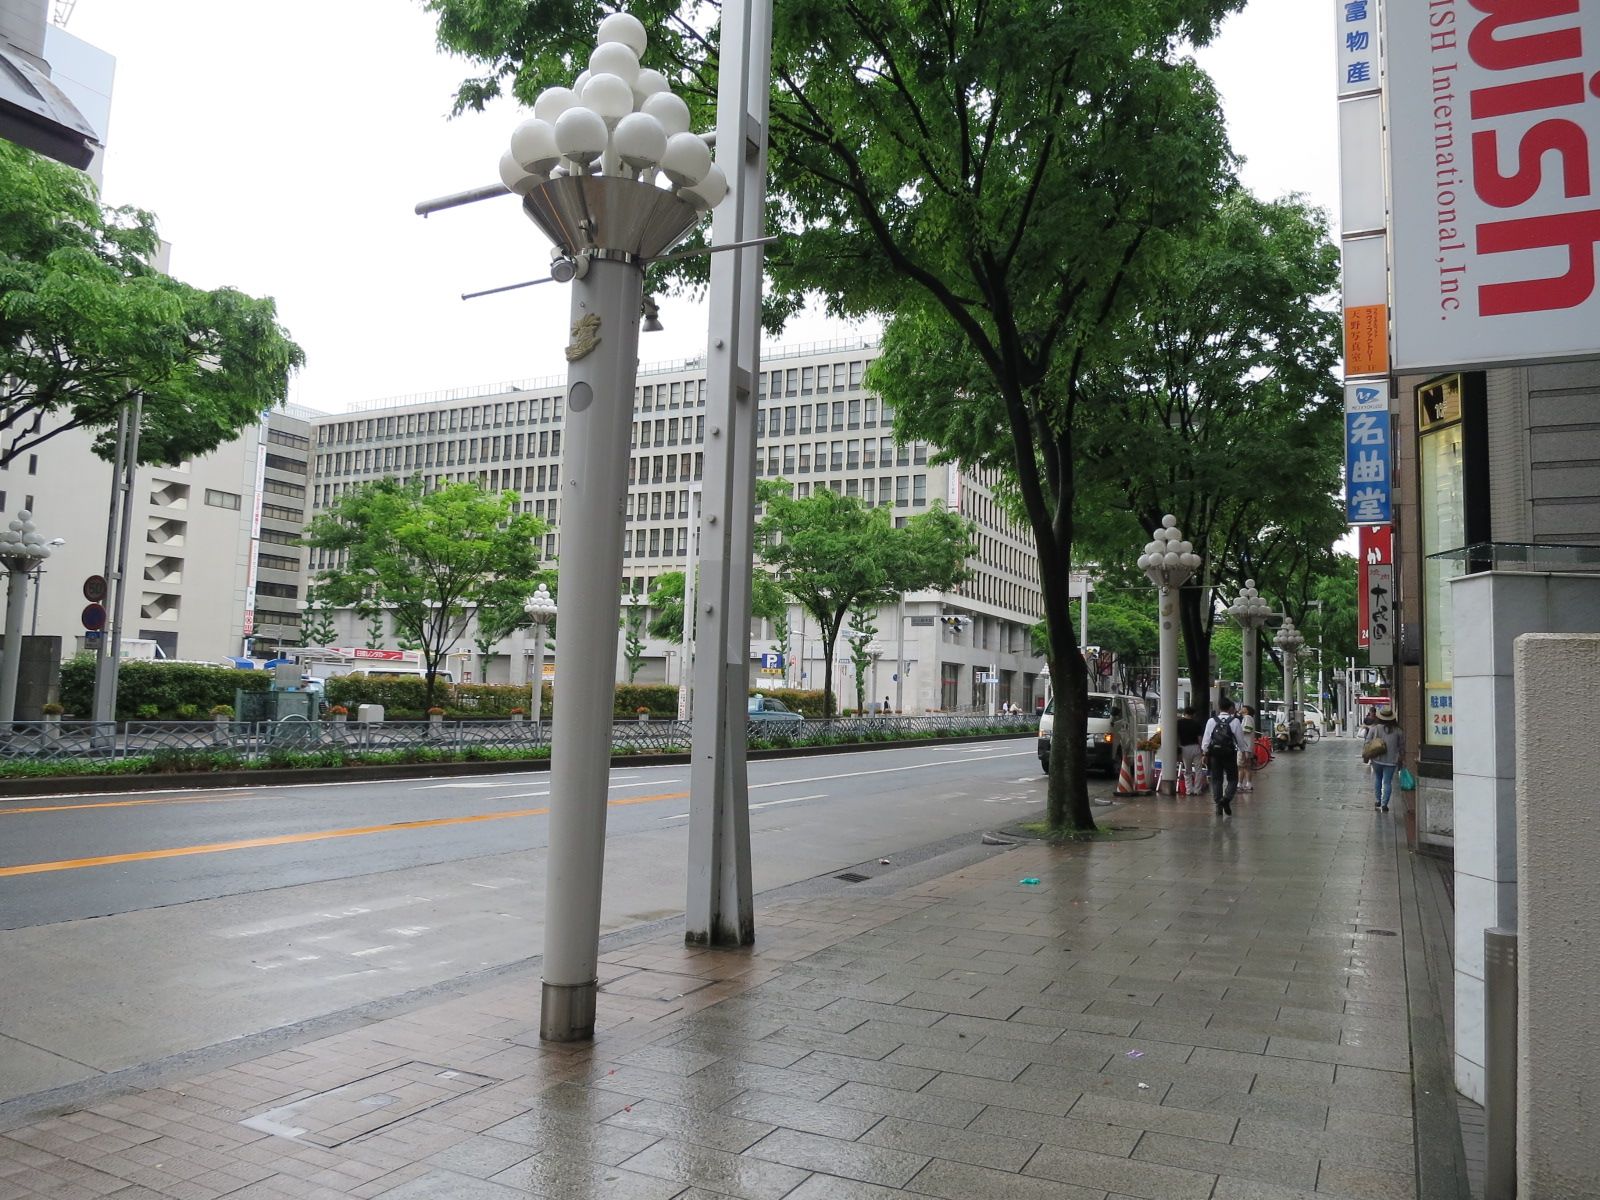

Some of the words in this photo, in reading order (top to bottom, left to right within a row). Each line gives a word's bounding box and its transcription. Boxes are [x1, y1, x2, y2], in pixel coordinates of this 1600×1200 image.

[1431, 62, 1467, 321] International,Inc.
[1350, 413, 1386, 520] 名曲堂
